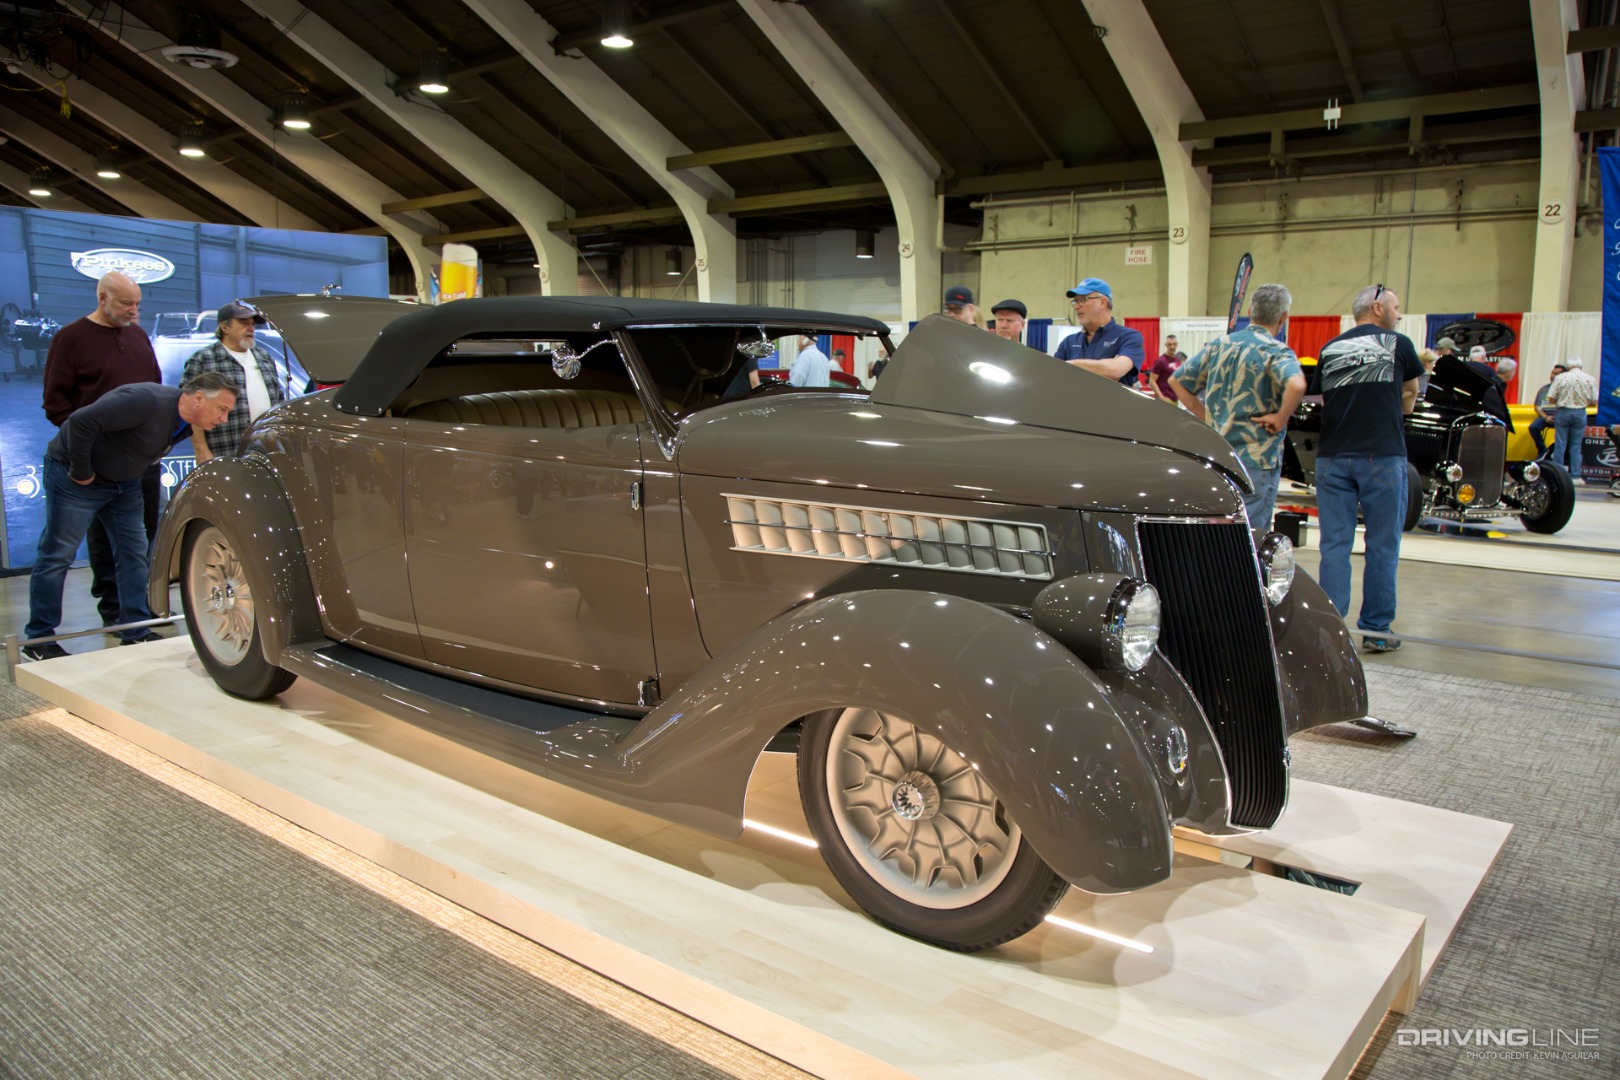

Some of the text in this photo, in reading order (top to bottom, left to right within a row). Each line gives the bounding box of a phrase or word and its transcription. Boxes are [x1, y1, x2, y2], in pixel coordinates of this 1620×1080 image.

[1544, 204, 1561, 217] 22
[1173, 227, 1185, 238] 23
[80, 256, 166, 271] Pinkees
[1585, 438, 1605, 446] ONE
